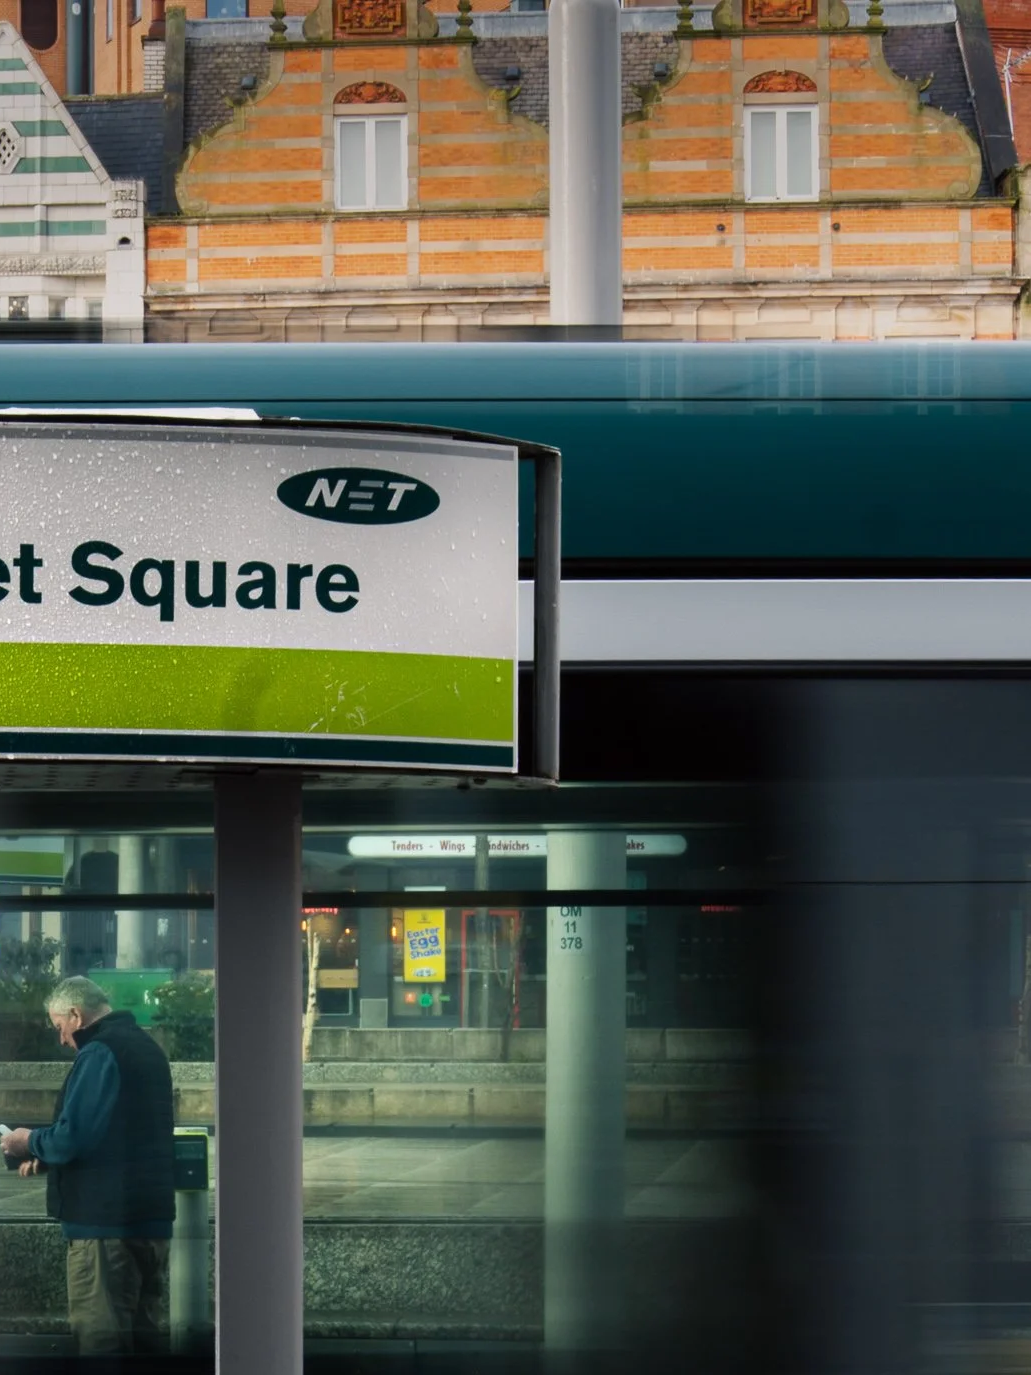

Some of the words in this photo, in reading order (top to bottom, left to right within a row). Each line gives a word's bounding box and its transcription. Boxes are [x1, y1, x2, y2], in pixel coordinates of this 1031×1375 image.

[305, 477, 418, 511] NET
[70, 540, 359, 621] Square
[391, 839, 424, 851] Tenders
[440, 840, 466, 853] Wings
[560, 905, 582, 918] OM
[407, 927, 440, 939] Easter
[564, 920, 577, 934] 11
[409, 935, 439, 950] Egg
[560, 937, 583, 950] 378
[410, 948, 441, 960] Shake
